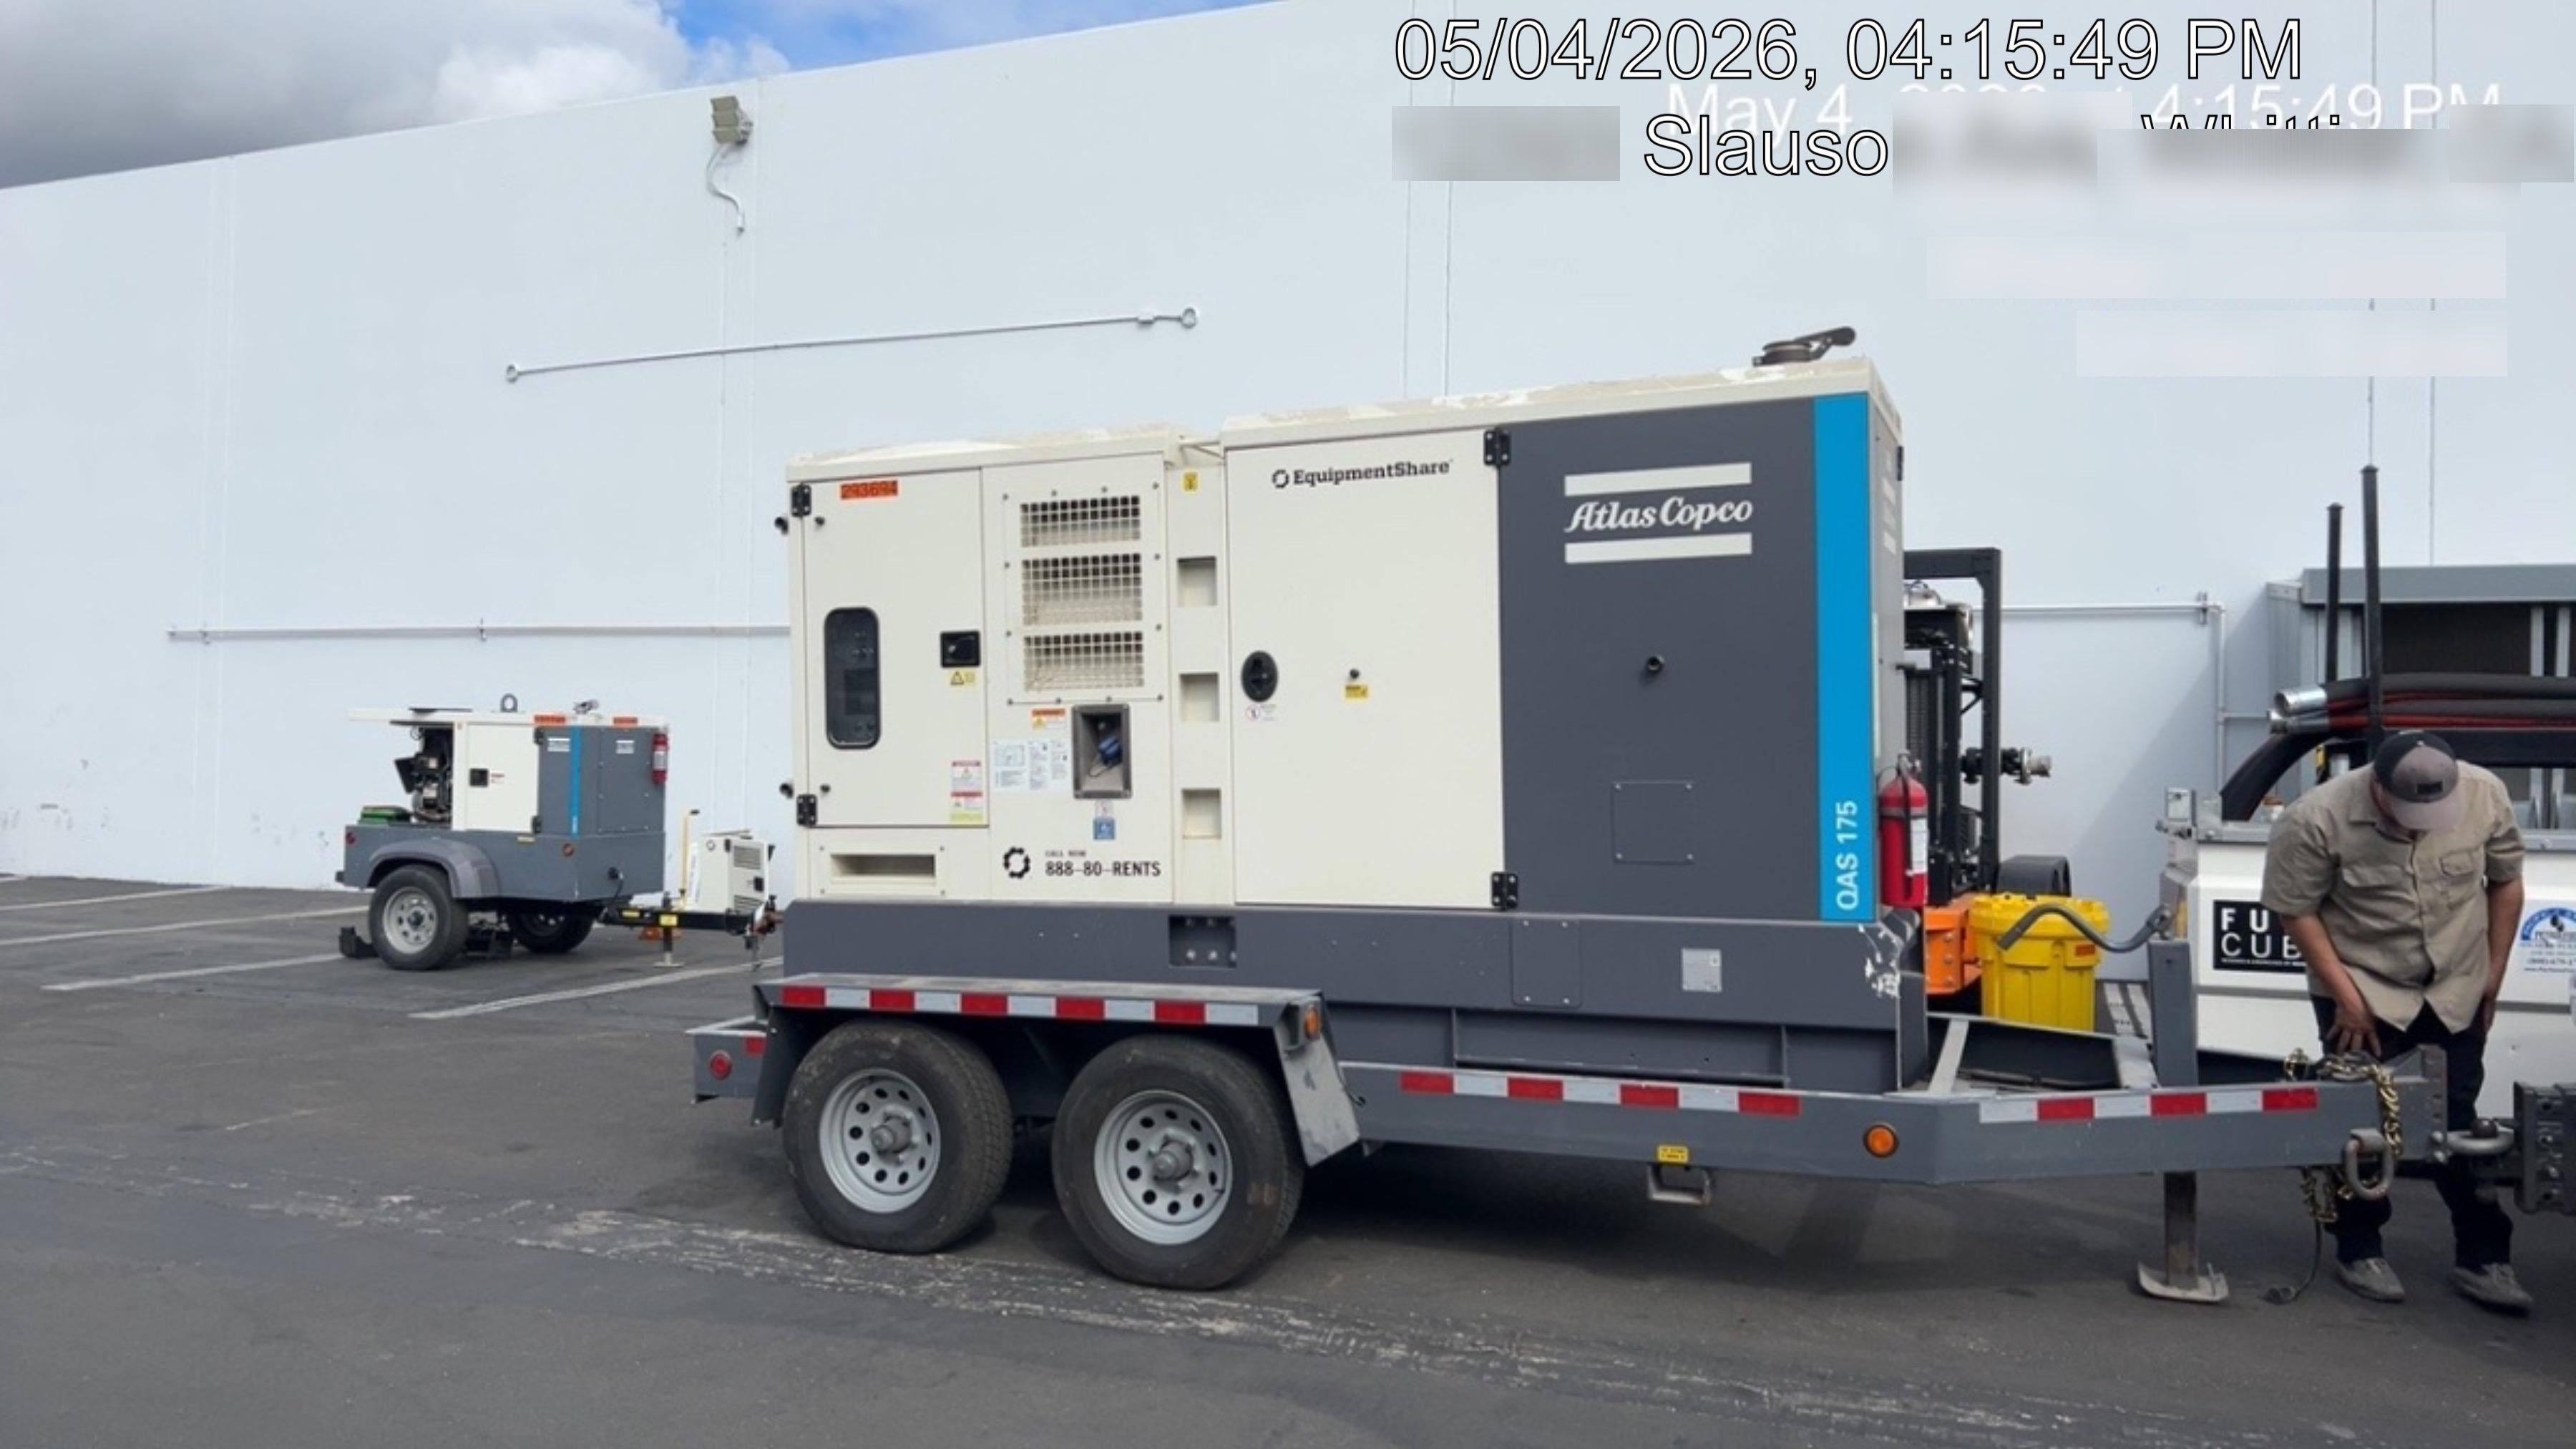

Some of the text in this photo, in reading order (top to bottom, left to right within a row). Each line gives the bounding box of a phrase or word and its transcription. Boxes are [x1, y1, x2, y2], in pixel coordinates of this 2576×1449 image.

[1293, 460, 1450, 487] EquipmentShare
[1564, 495, 1753, 532] Atlas Copco
[1045, 861, 1161, 877] 888-80-RENTS
[1835, 800, 1859, 911] QAS 175
[2220, 907, 2270, 933] FU
[2220, 932, 2302, 959] CUB
